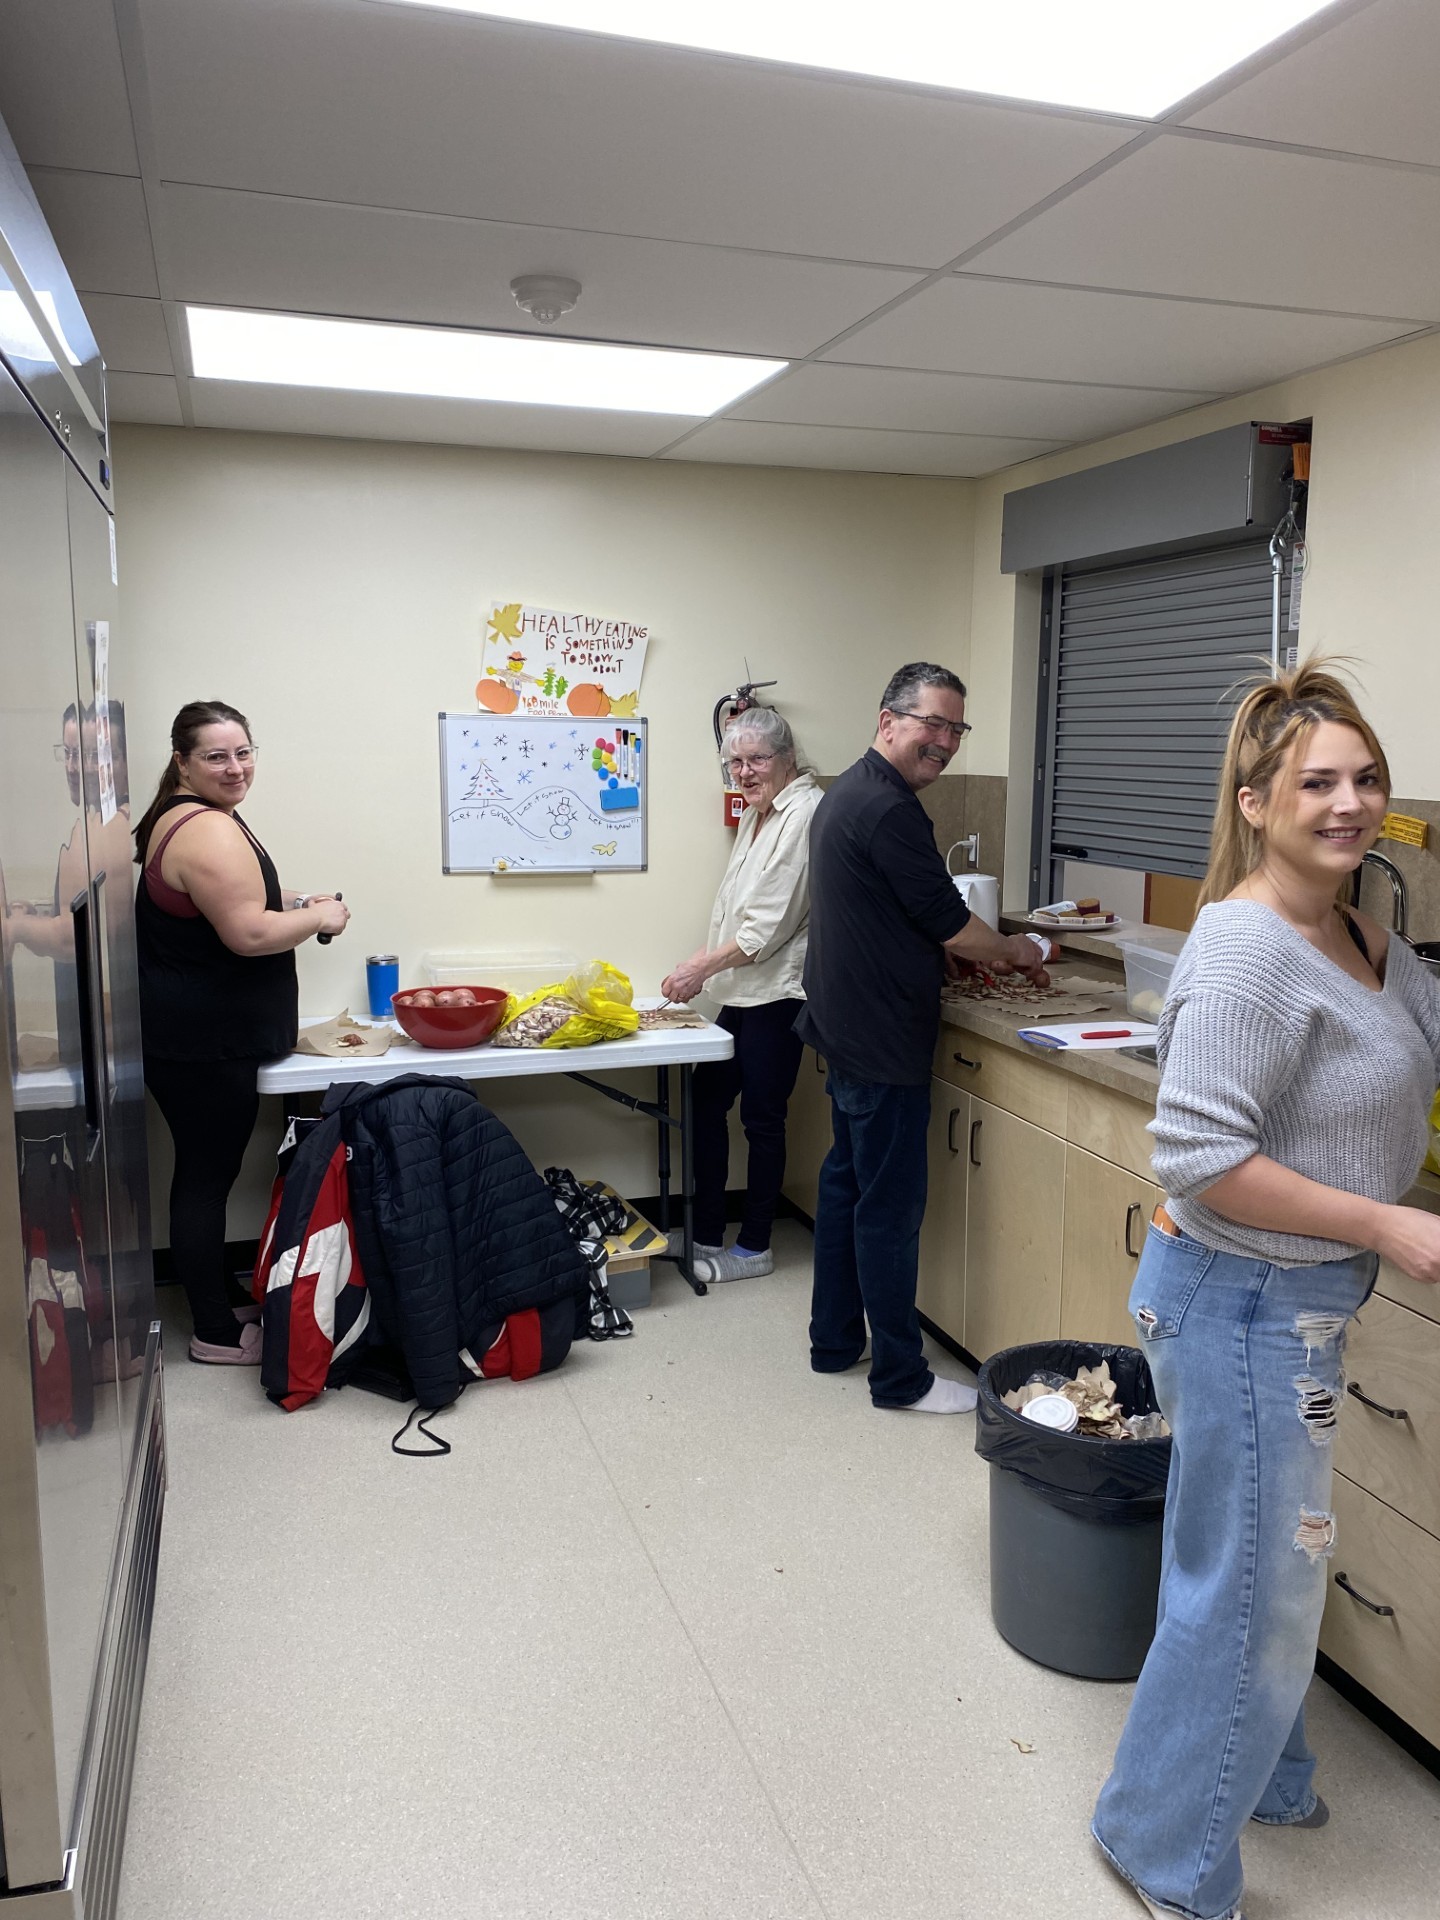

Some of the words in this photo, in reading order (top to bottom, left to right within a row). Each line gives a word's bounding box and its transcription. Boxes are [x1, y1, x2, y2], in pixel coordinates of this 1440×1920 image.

[522, 612, 603, 635] HEALTHY
[605, 622, 648, 639] EATING
[451, 811, 471, 823] Let
